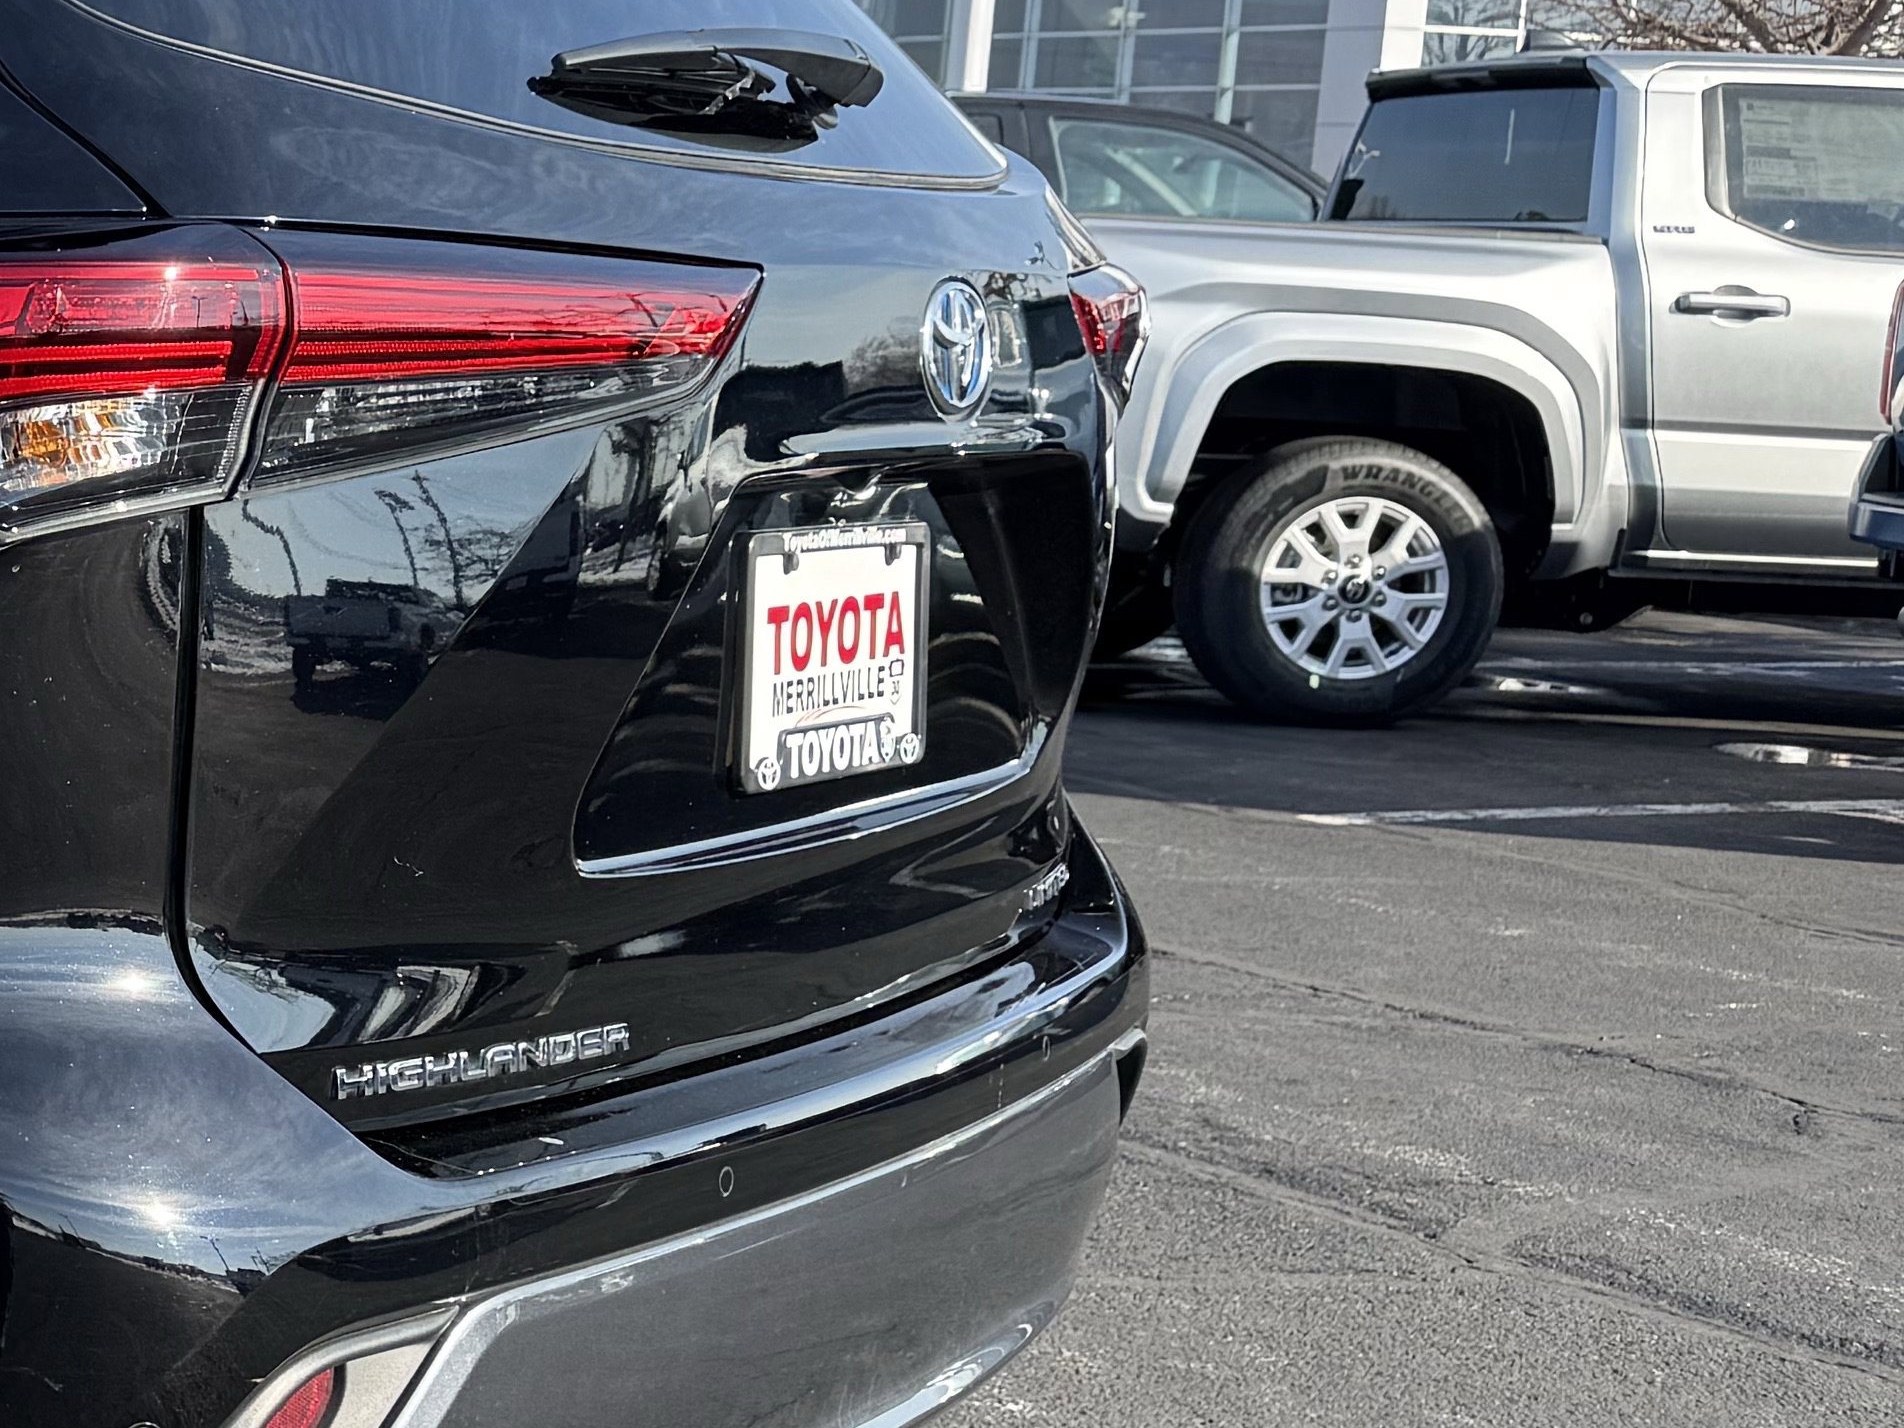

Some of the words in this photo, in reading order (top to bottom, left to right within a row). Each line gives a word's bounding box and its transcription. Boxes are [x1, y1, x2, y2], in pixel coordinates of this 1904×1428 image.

[767, 591, 905, 675] TOYOTA
[772, 666, 886, 717] MERRILLVILLE
[785, 720, 880, 779] TOYOTA
[331, 1022, 631, 1100] HIGHLANDER
